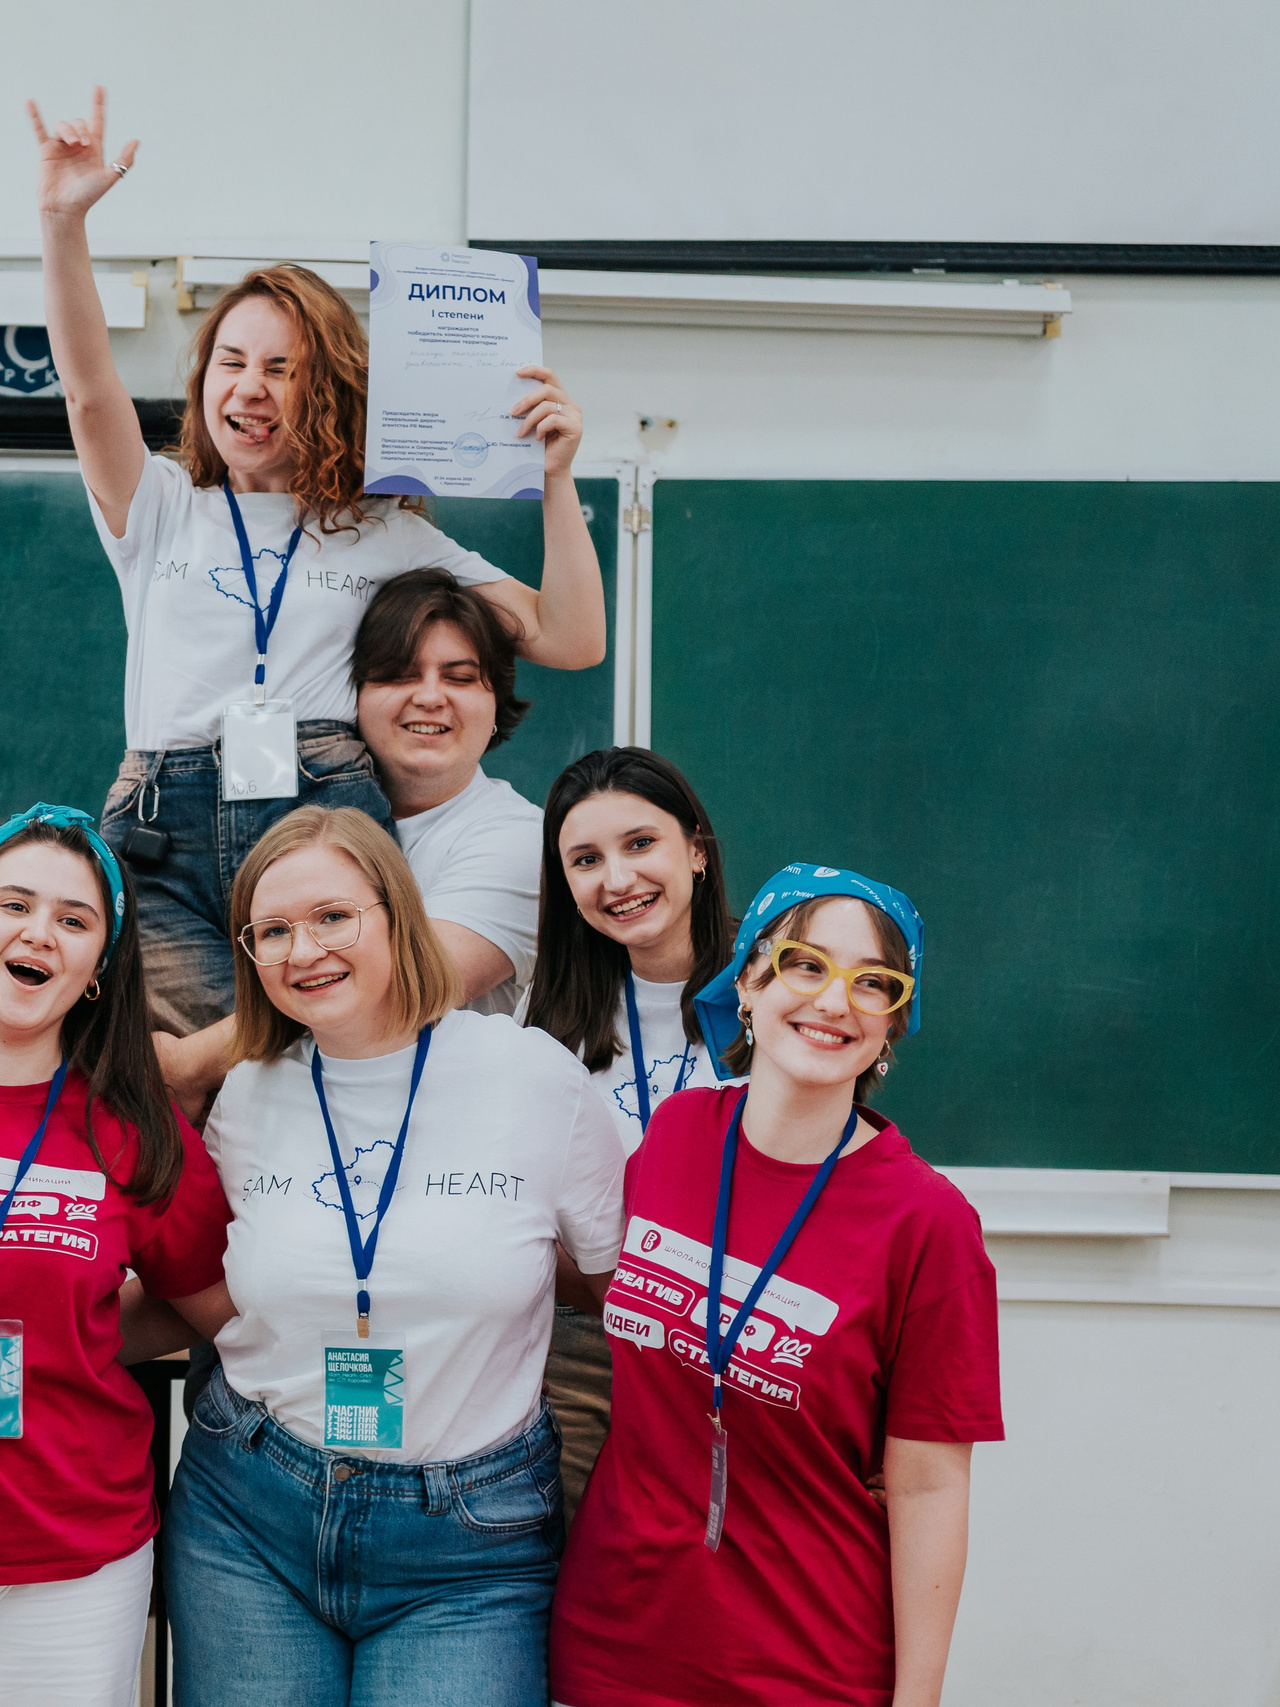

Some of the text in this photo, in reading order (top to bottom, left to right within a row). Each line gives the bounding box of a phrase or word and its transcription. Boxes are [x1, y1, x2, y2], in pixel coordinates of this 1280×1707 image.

[408, 283, 505, 304] ДИПЛОМ
[438, 311, 484, 320] степени
[154, 560, 375, 602] SAM HEART
[243, 1172, 525, 1201] SAM HEART
[664, 1245, 694, 1263] ШКОЛА
[328, 1352, 370, 1362] АНАСТАСИЯ
[605, 1311, 793, 1402] ИДЕИ СТРТЕГИЯ
[328, 1362, 373, 1373] ЩЕЛОЧКОВА
[327, 1405, 379, 1418] УЧАСТНИК
